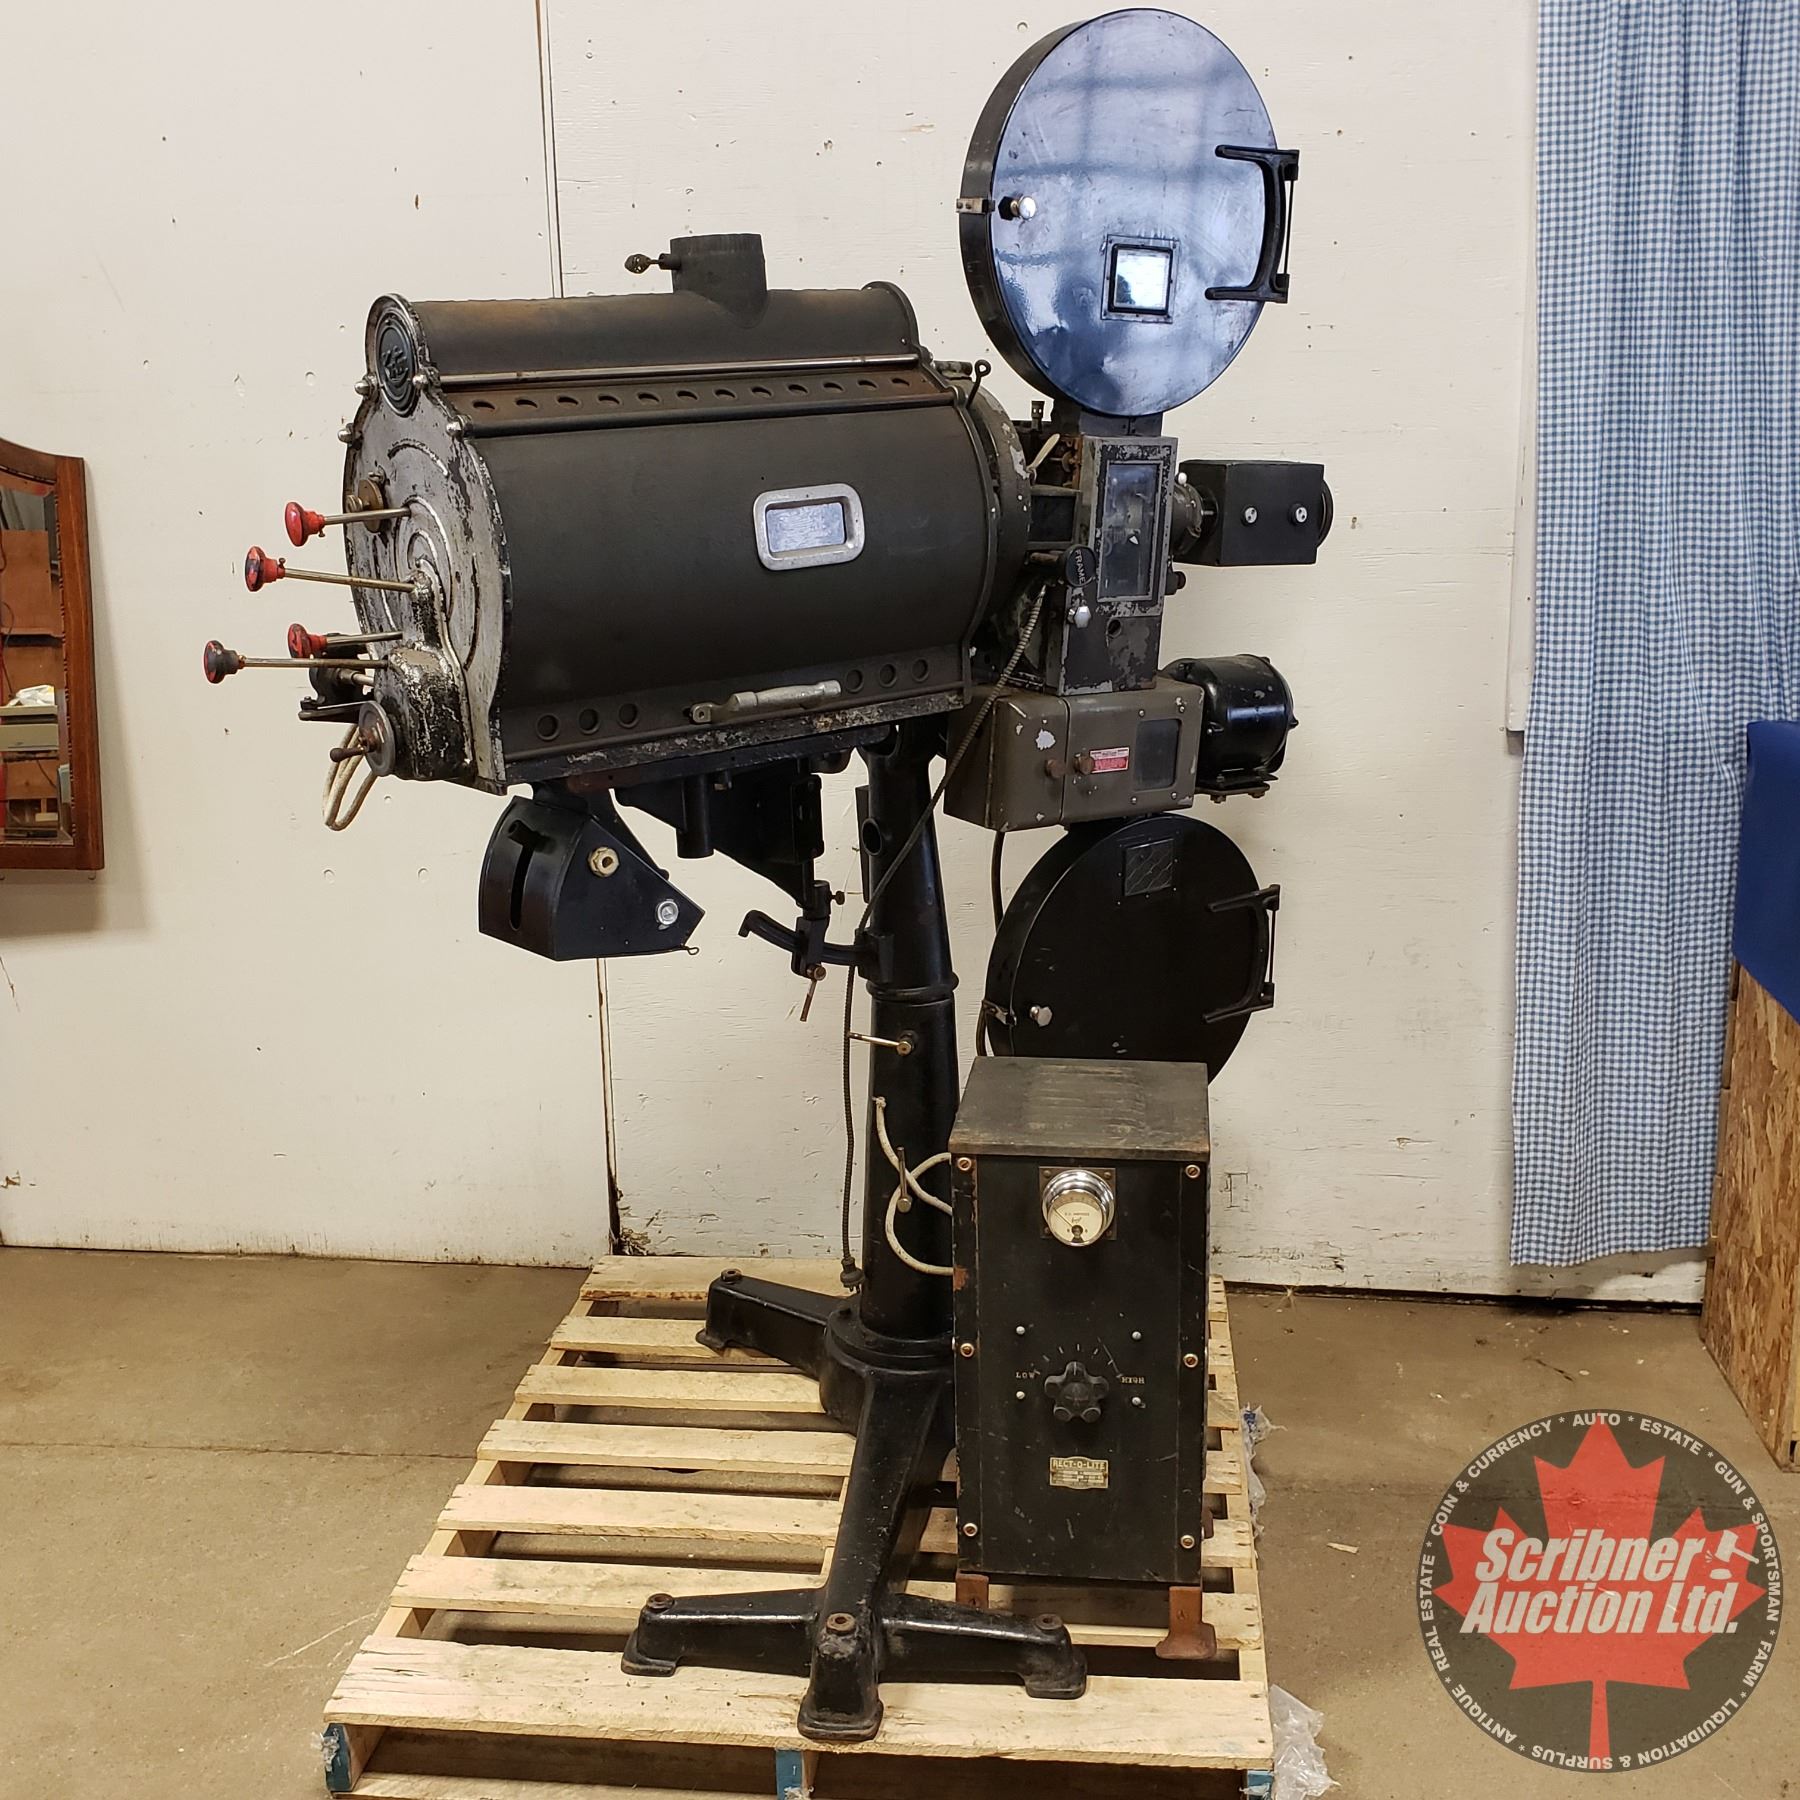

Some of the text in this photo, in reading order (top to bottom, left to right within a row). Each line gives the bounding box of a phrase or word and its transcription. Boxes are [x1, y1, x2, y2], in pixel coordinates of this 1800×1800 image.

[1075, 549, 1086, 585] FRAME
[1015, 1371, 1036, 1379] LOW
[1121, 1376, 1145, 1385] HIGH
[1052, 1459, 1106, 1470] RECT-O-LITE
